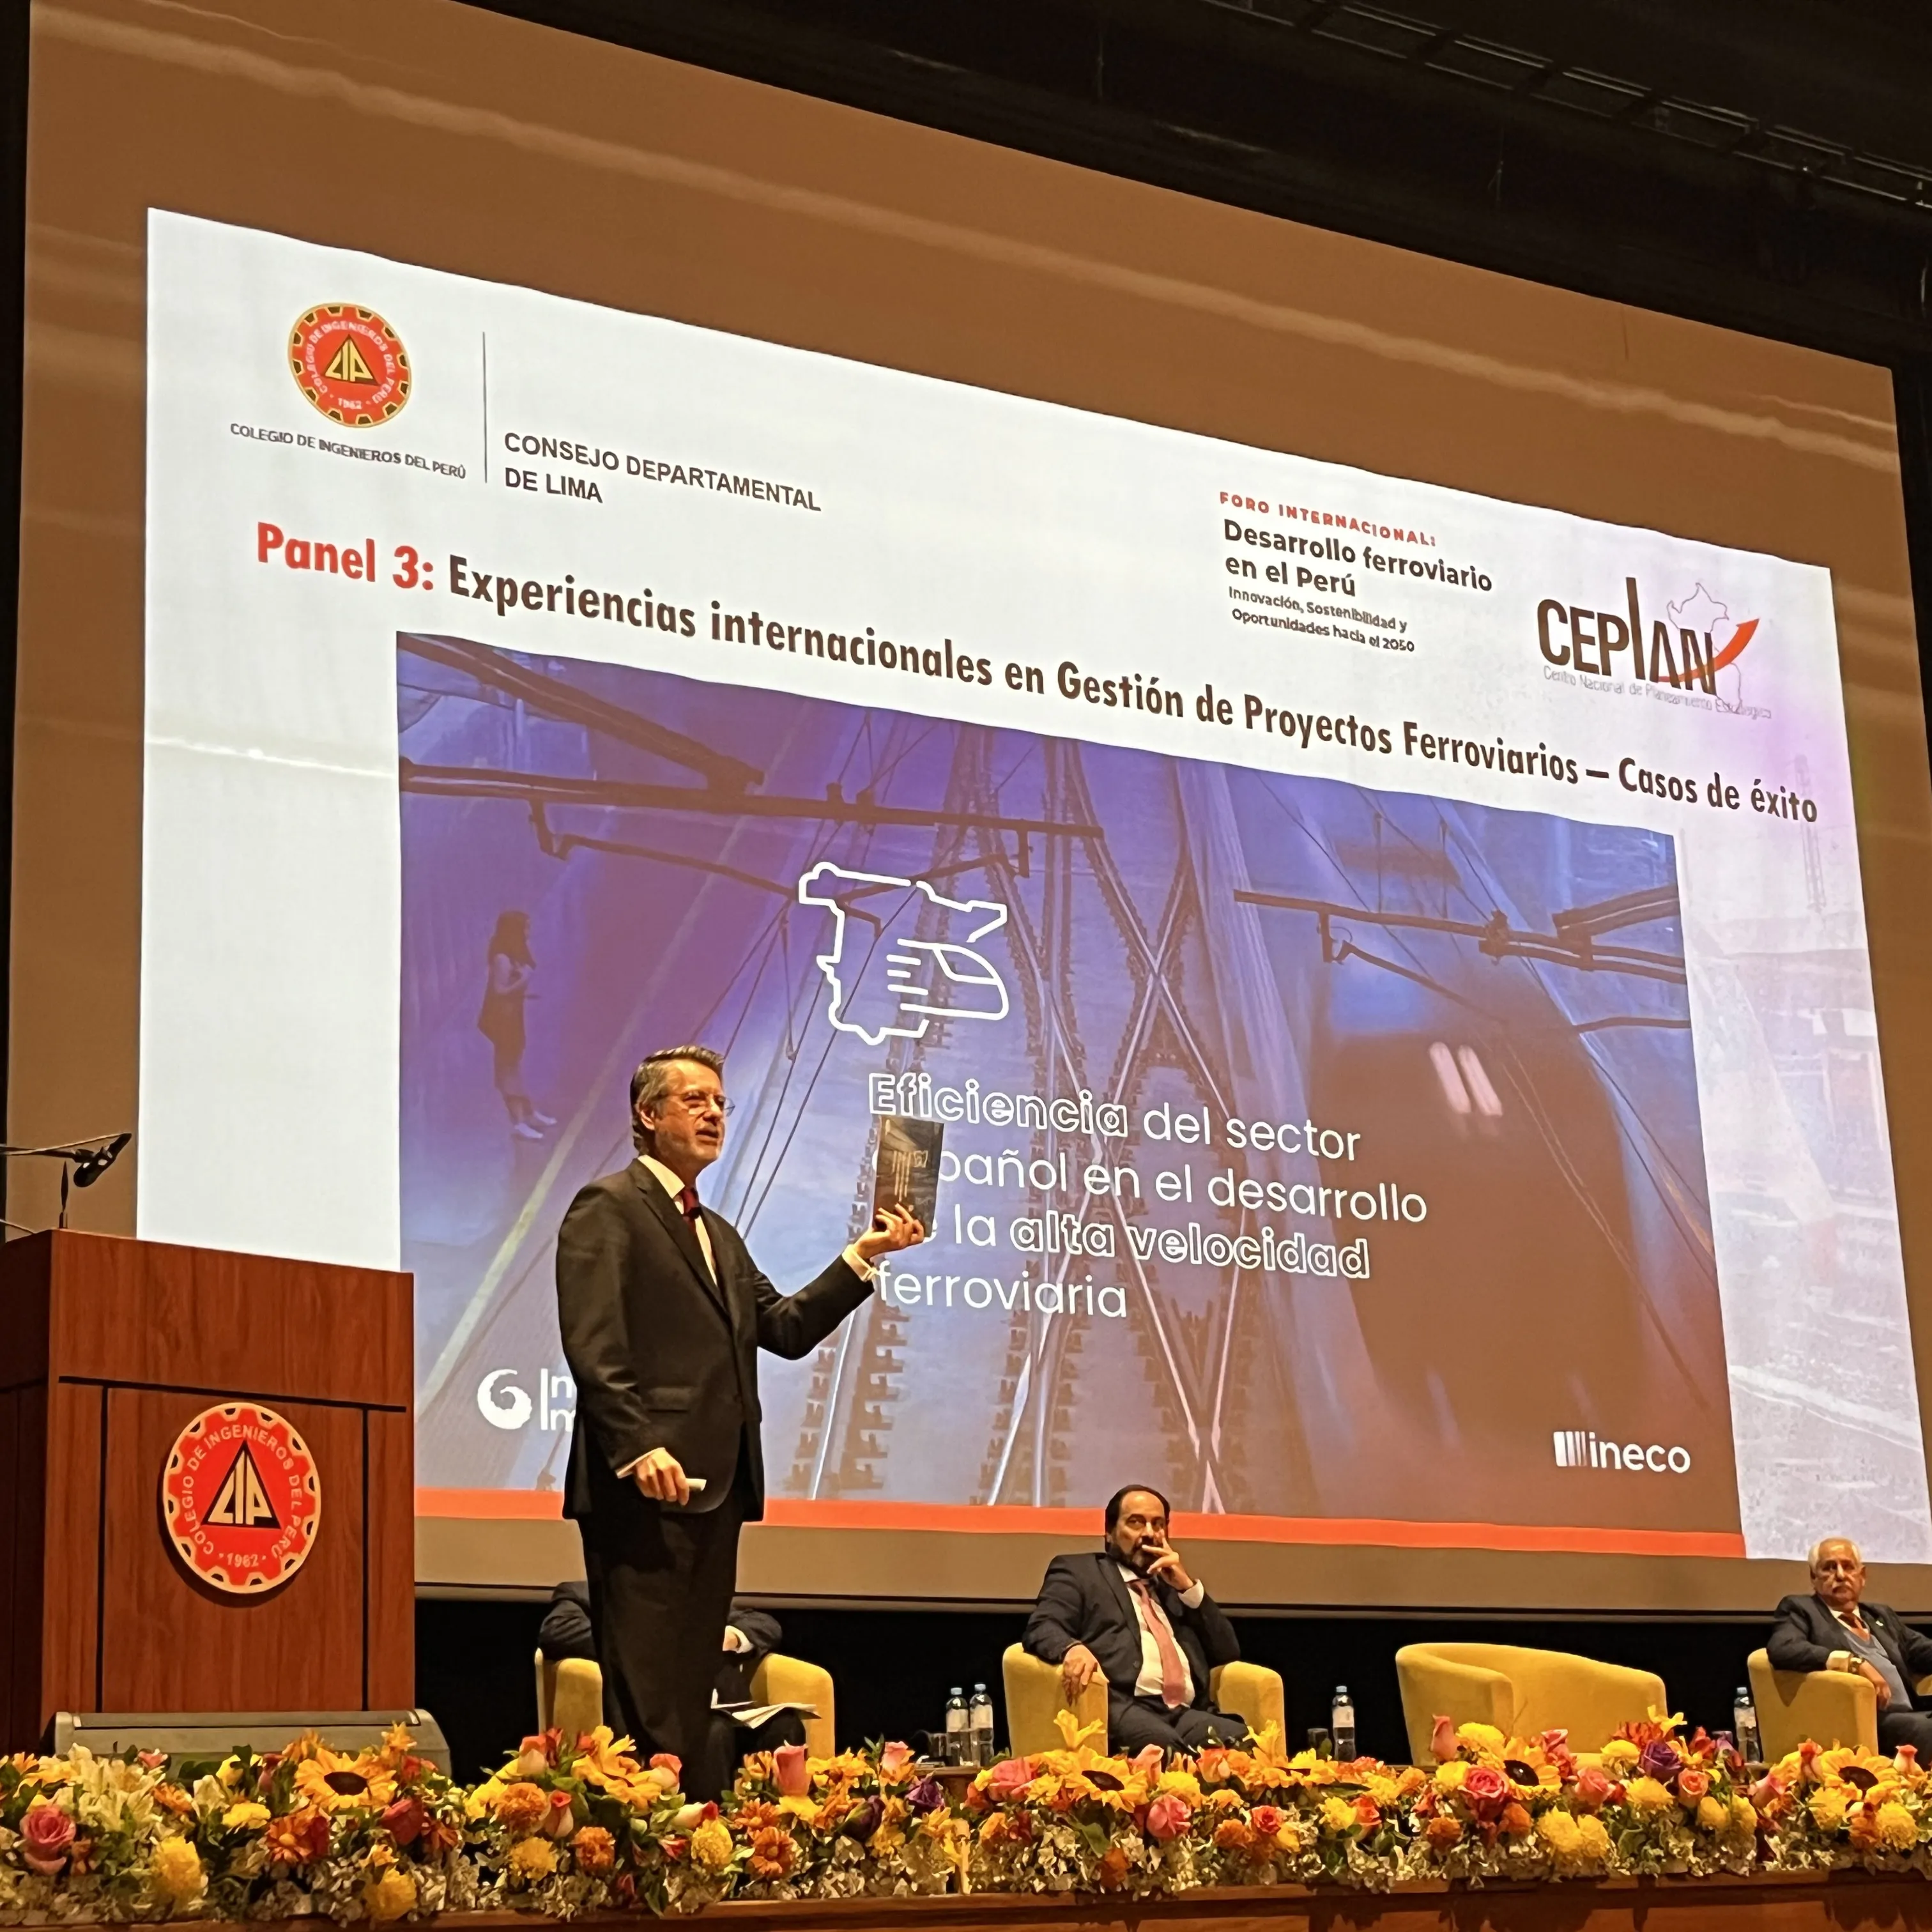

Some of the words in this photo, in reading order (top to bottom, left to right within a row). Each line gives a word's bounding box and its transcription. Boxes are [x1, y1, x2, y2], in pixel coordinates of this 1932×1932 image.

[231, 423, 293, 444] COLEGIO
[297, 434, 315, 448] DE
[319, 439, 401, 463] INGENIEROS
[405, 454, 430, 470] DEL
[433, 461, 466, 479] PERÚ
[505, 433, 619, 470] CONSEJO
[626, 455, 822, 512] DEPARTAMENTAL
[505, 467, 538, 492] DE
[546, 473, 603, 503] LIMA
[1220, 492, 1269, 513] FORO
[1279, 503, 1436, 547] INTERNACIONAL:
[1224, 519, 1356, 563] Desarrollo
[1363, 546, 1492, 592] ferroviario
[1225, 557, 1257, 579] en
[1266, 562, 1288, 585] el
[1296, 567, 1356, 597] Perú
[1229, 586, 1304, 613] Innovación,
[1307, 602, 1396, 629] Sostenibilidad
[1399, 620, 1407, 633] y
[1232, 608, 1330, 636] Oportunidades
[1333, 625, 1366, 644] hacia
[1369, 636, 1380, 648] el
[1383, 638, 1414, 652] 2050
[257, 522, 375, 581] Panel
[394, 545, 433, 590] 3:
[450, 554, 696, 638] Experiencias
[711, 600, 992, 686] internacionales
[1005, 663, 1045, 694] en
[1057, 661, 1184, 717] Gestión
[1196, 684, 1233, 726] de
[1244, 694, 1392, 754] Proyectos
[1403, 721, 1579, 785] Ferroviarios
[1618, 757, 1698, 804] Casos
[1707, 772, 1740, 810] de
[1751, 778, 1818, 823] éxito
[1629, 683, 1643, 696] de
[869, 1073, 1128, 1138] Eficiencia
[1144, 1101, 1211, 1145] del
[1226, 1118, 1361, 1162] sector
[1084, 1163, 1141, 1199] en
[1155, 1165, 1192, 1203] el
[1208, 1170, 1428, 1222] desarrollo
[954, 1204, 997, 1246] la
[1009, 1210, 1116, 1258] alta
[1125, 1222, 1370, 1279] velocidad
[878, 1260, 1128, 1318] ferroviaria
[187, 1445, 207, 1471] DE
[205, 1424, 295, 1471] INGENIEROS
[1588, 1431, 1690, 1473] ineco
[181, 1476, 214, 1555] COLEGIO
[289, 1474, 303, 1510] DEL
[227, 1552, 259, 1568] 1962
